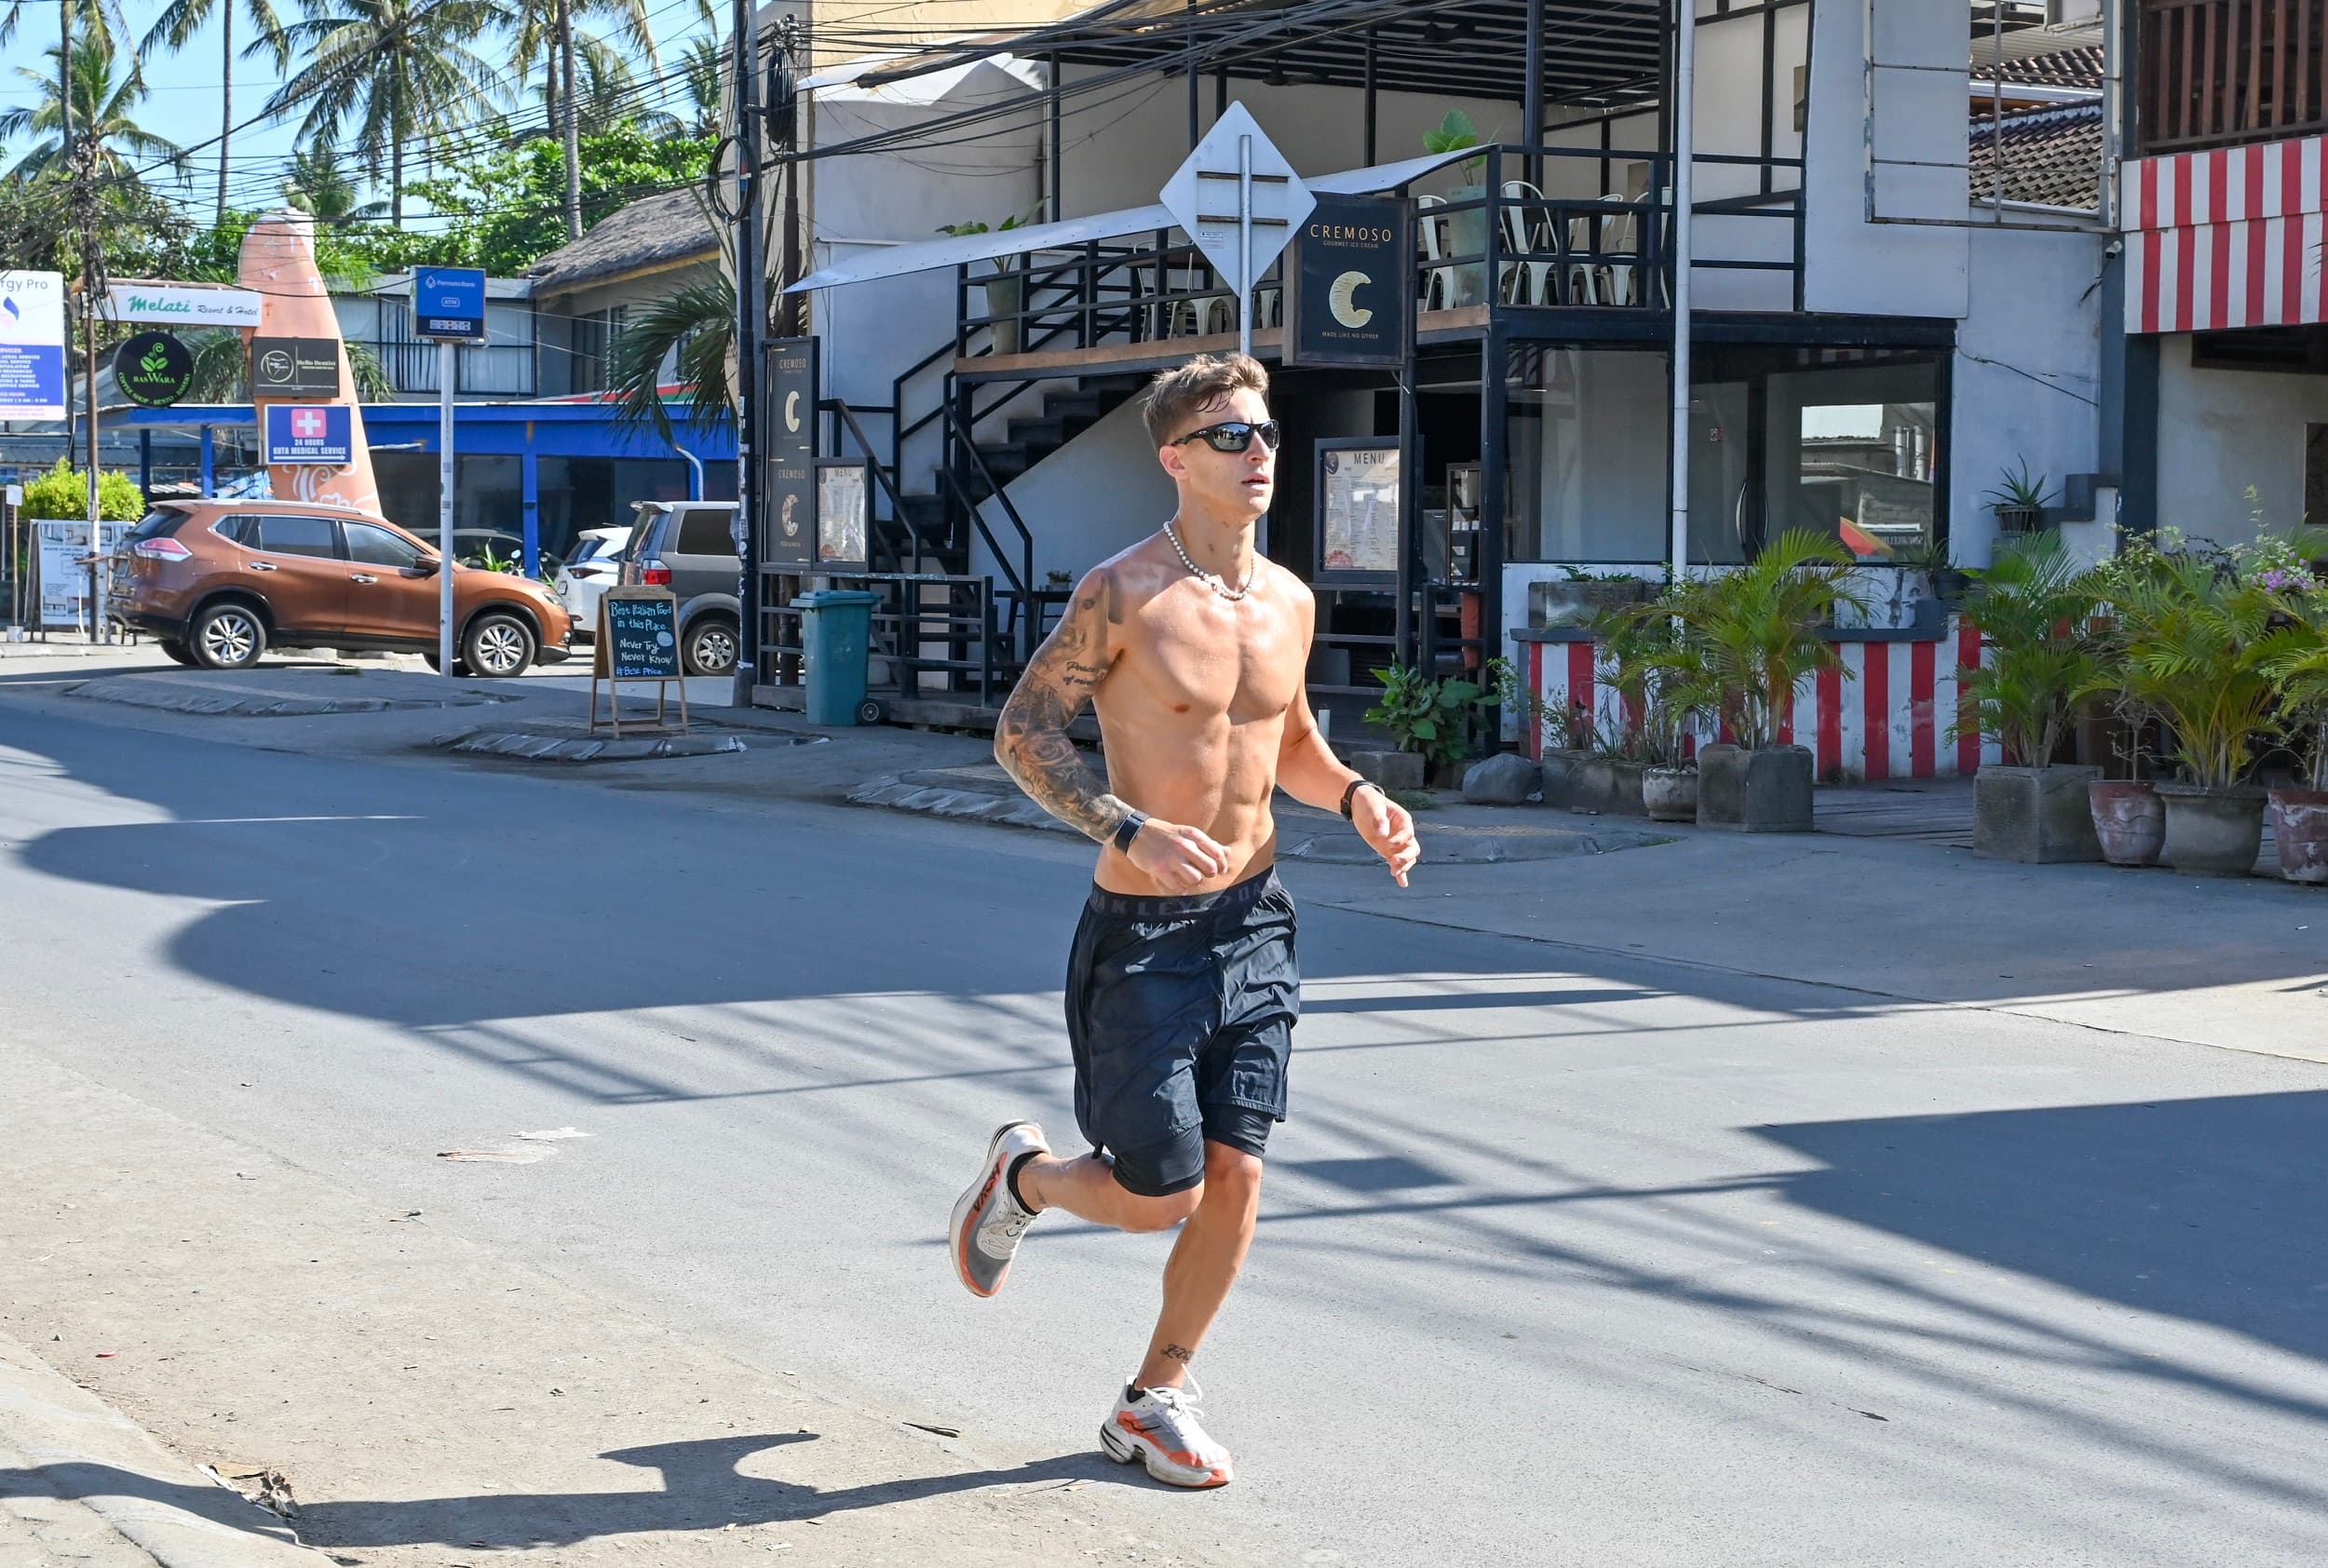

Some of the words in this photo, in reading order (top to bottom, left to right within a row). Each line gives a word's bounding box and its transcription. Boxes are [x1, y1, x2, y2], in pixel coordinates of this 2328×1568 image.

[1310, 223, 1391, 242] CREMOSO
[27, 278, 47, 290] Pro
[128, 295, 191, 313] Melati
[196, 304, 223, 314] Resort
[226, 305, 233, 314] &
[235, 306, 258, 316] Hotel
[779, 358, 806, 370] CREMOSO
[291, 447, 318, 455] MEDICAL
[320, 447, 346, 455] SERVICE
[1354, 453, 1385, 465] MENU
[778, 468, 805, 479] CREMOSO
[611, 602, 630, 616] Best
[632, 604, 656, 616] Italian
[656, 602, 671, 615] Food
[617, 617, 625, 628] in
[629, 618, 643, 629] this
[619, 638, 643, 649] Never
[643, 641, 659, 655] Try
[621, 652, 645, 662] Never
[1062, 675, 1075, 686] of
[1092, 890, 1193, 915] OAKLEY
